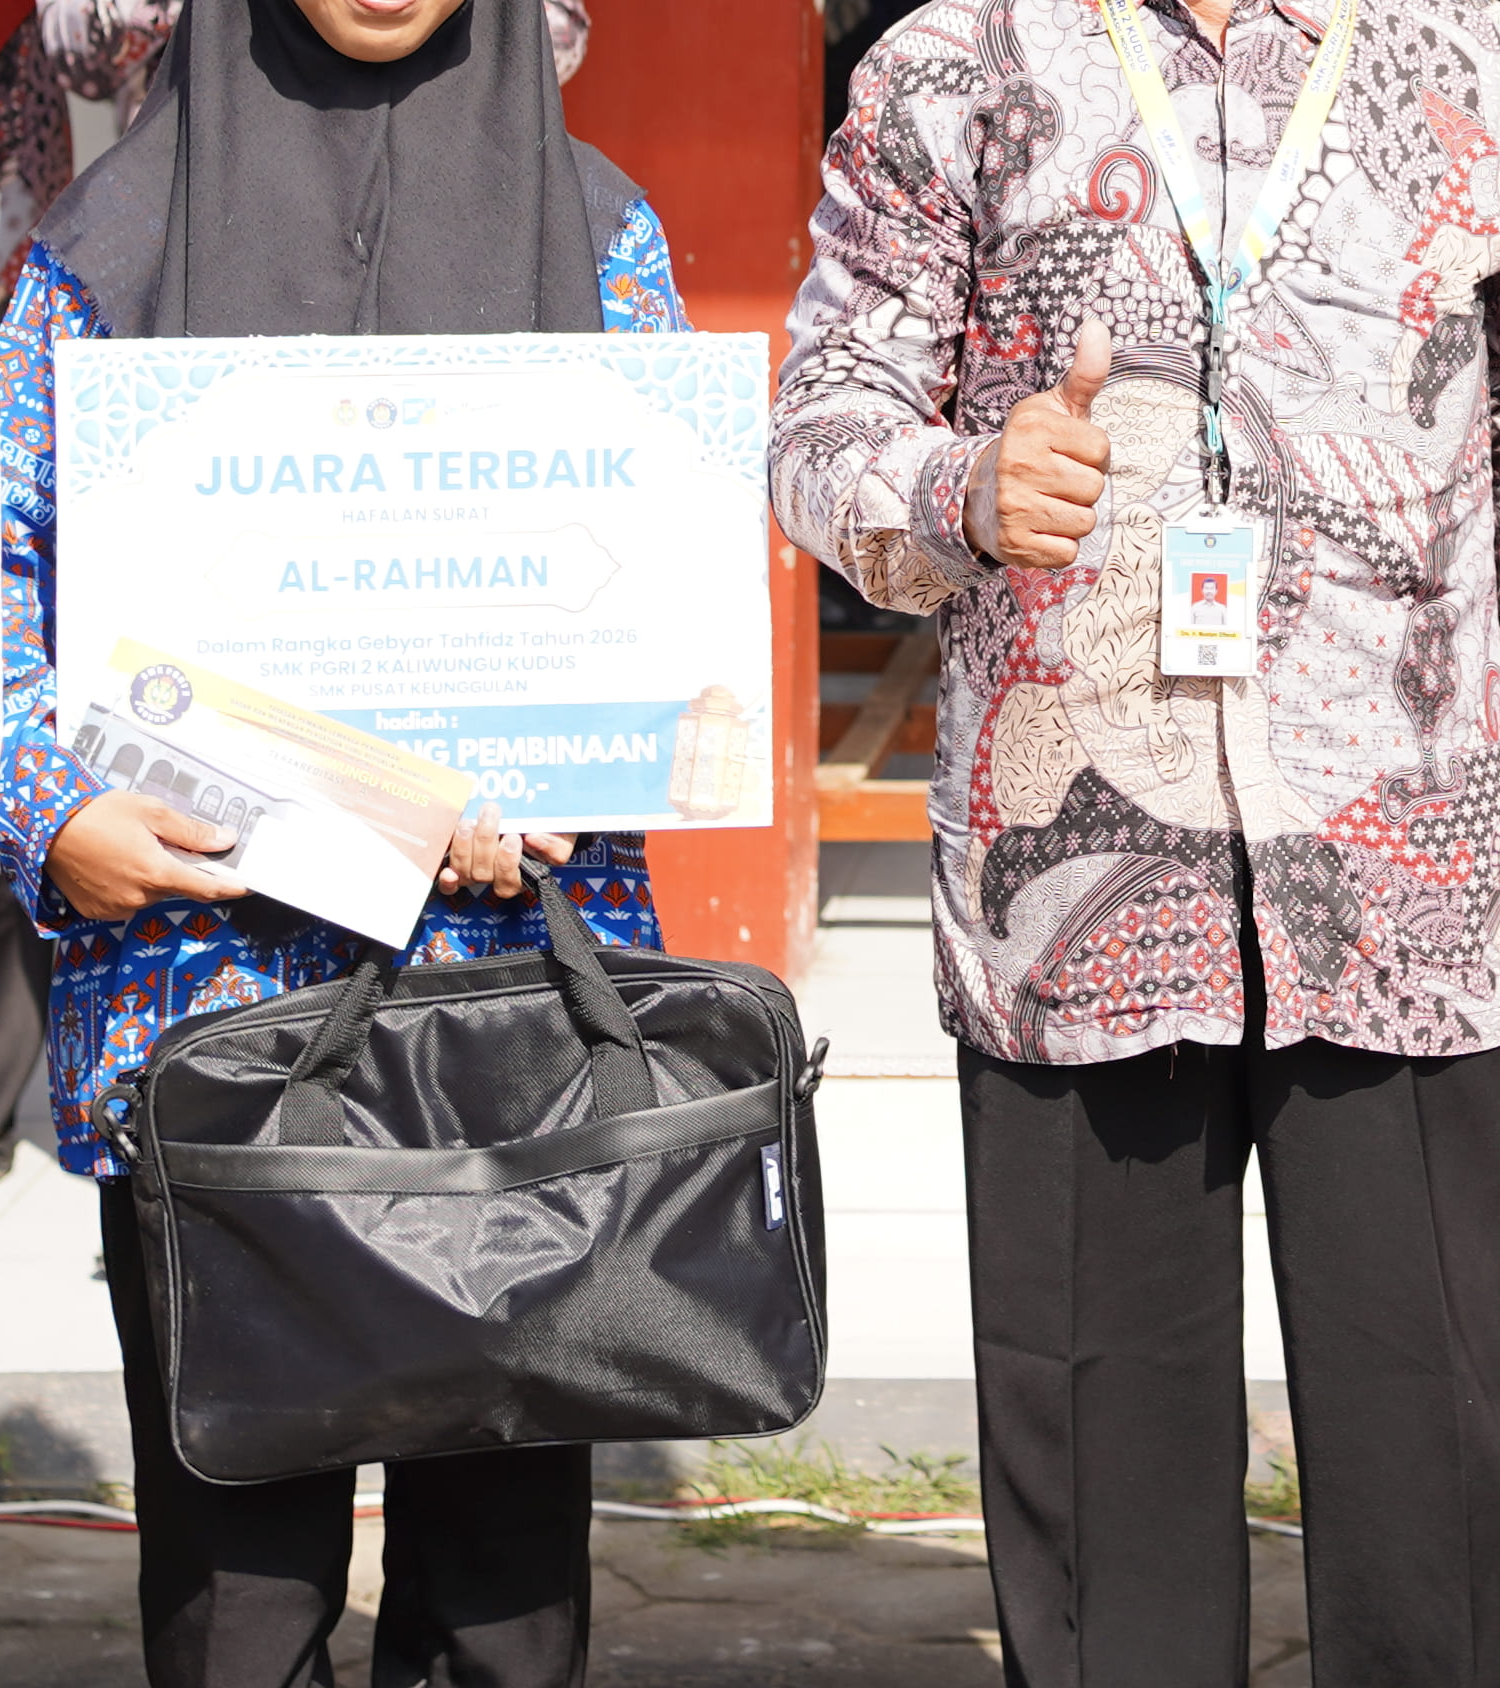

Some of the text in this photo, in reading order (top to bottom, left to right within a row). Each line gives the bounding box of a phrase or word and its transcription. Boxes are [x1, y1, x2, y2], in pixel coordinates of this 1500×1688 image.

[1121, 14, 1132, 24] 2
[1126, 26, 1152, 73] KUDUS
[1309, 65, 1328, 94] SMK
[1321, 31, 1341, 63] PGRI
[1335, 21, 1345, 31] 2
[194, 446, 635, 496] JUARA TERBAIK
[341, 505, 488, 523] HAFALAN SURAT
[277, 554, 548, 592] AL-RAHMAN
[196, 627, 637, 657] Dalam Rangka Gebyar Tahfidz Tahun 2026
[258, 654, 576, 677] SMK PGRI 2 KALIWUNGU KUDUS
[308, 678, 528, 697] SMK PUSAT KEUNGGULAN
[374, 708, 447, 731] hadiah
[454, 731, 657, 771] PEMBINAAN
[266, 748, 347, 788] TERAKREDITASI
[378, 777, 433, 810] KUDUS
